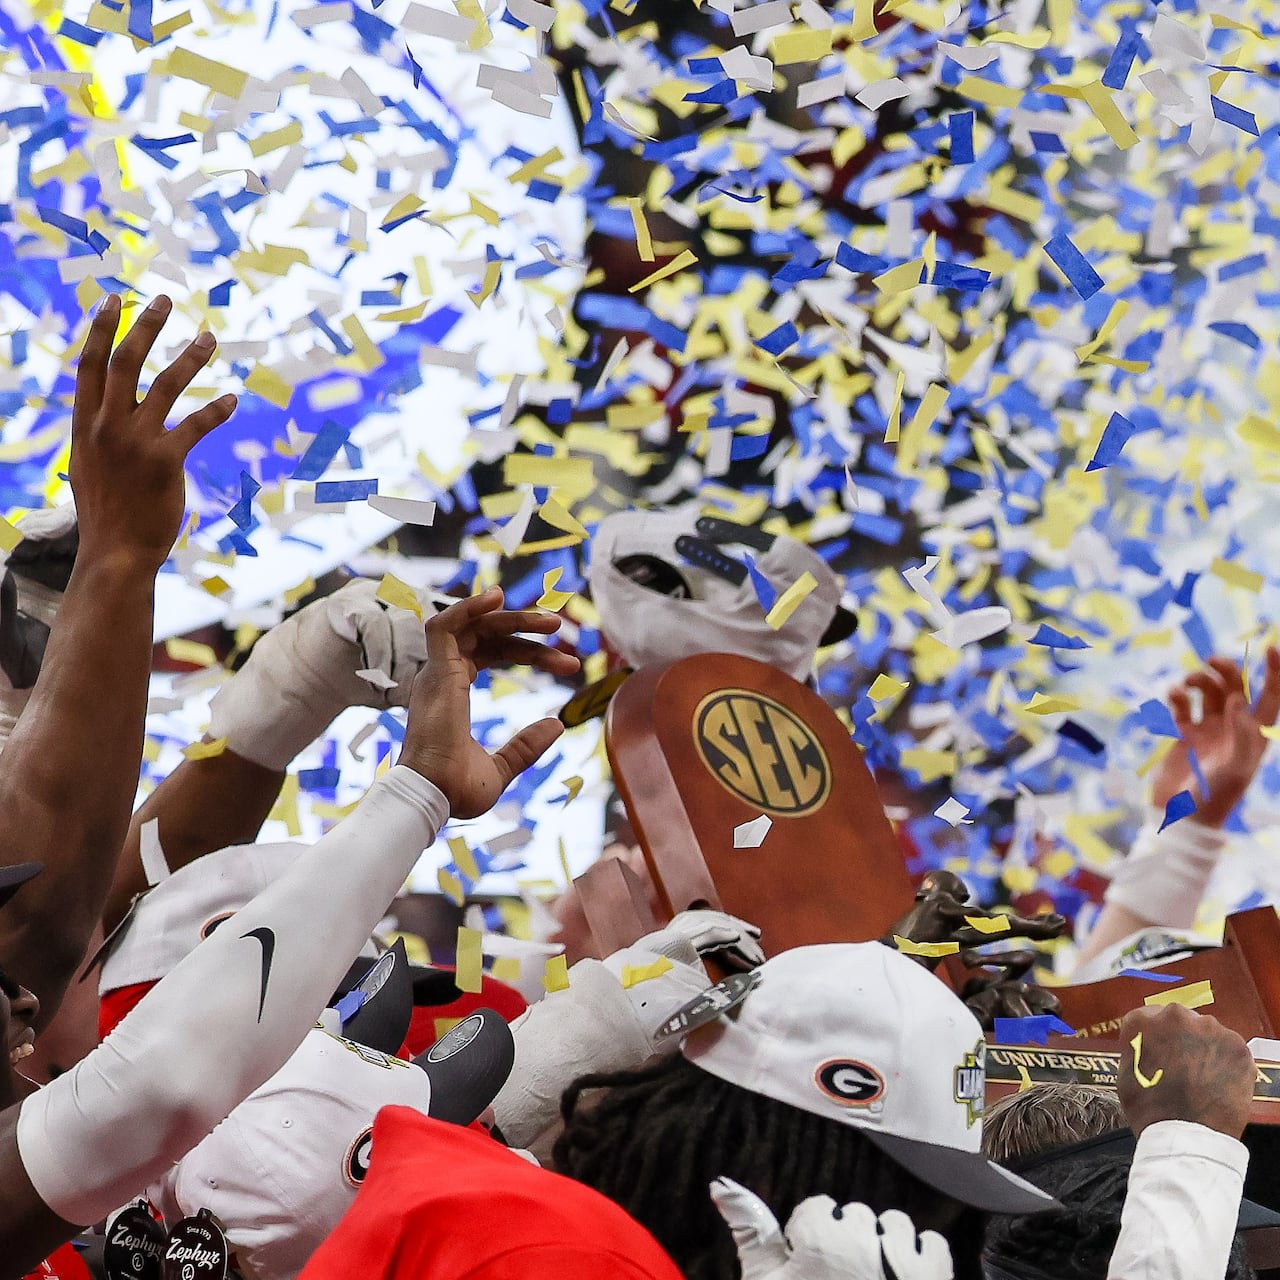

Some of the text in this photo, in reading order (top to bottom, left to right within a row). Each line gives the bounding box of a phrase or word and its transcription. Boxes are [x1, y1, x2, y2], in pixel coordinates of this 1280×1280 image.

[703, 699, 823, 808] SEC
[820, 1063, 880, 1100] G
[112, 1224, 161, 1261] Zephy
[166, 1237, 220, 1270] Zephyr
